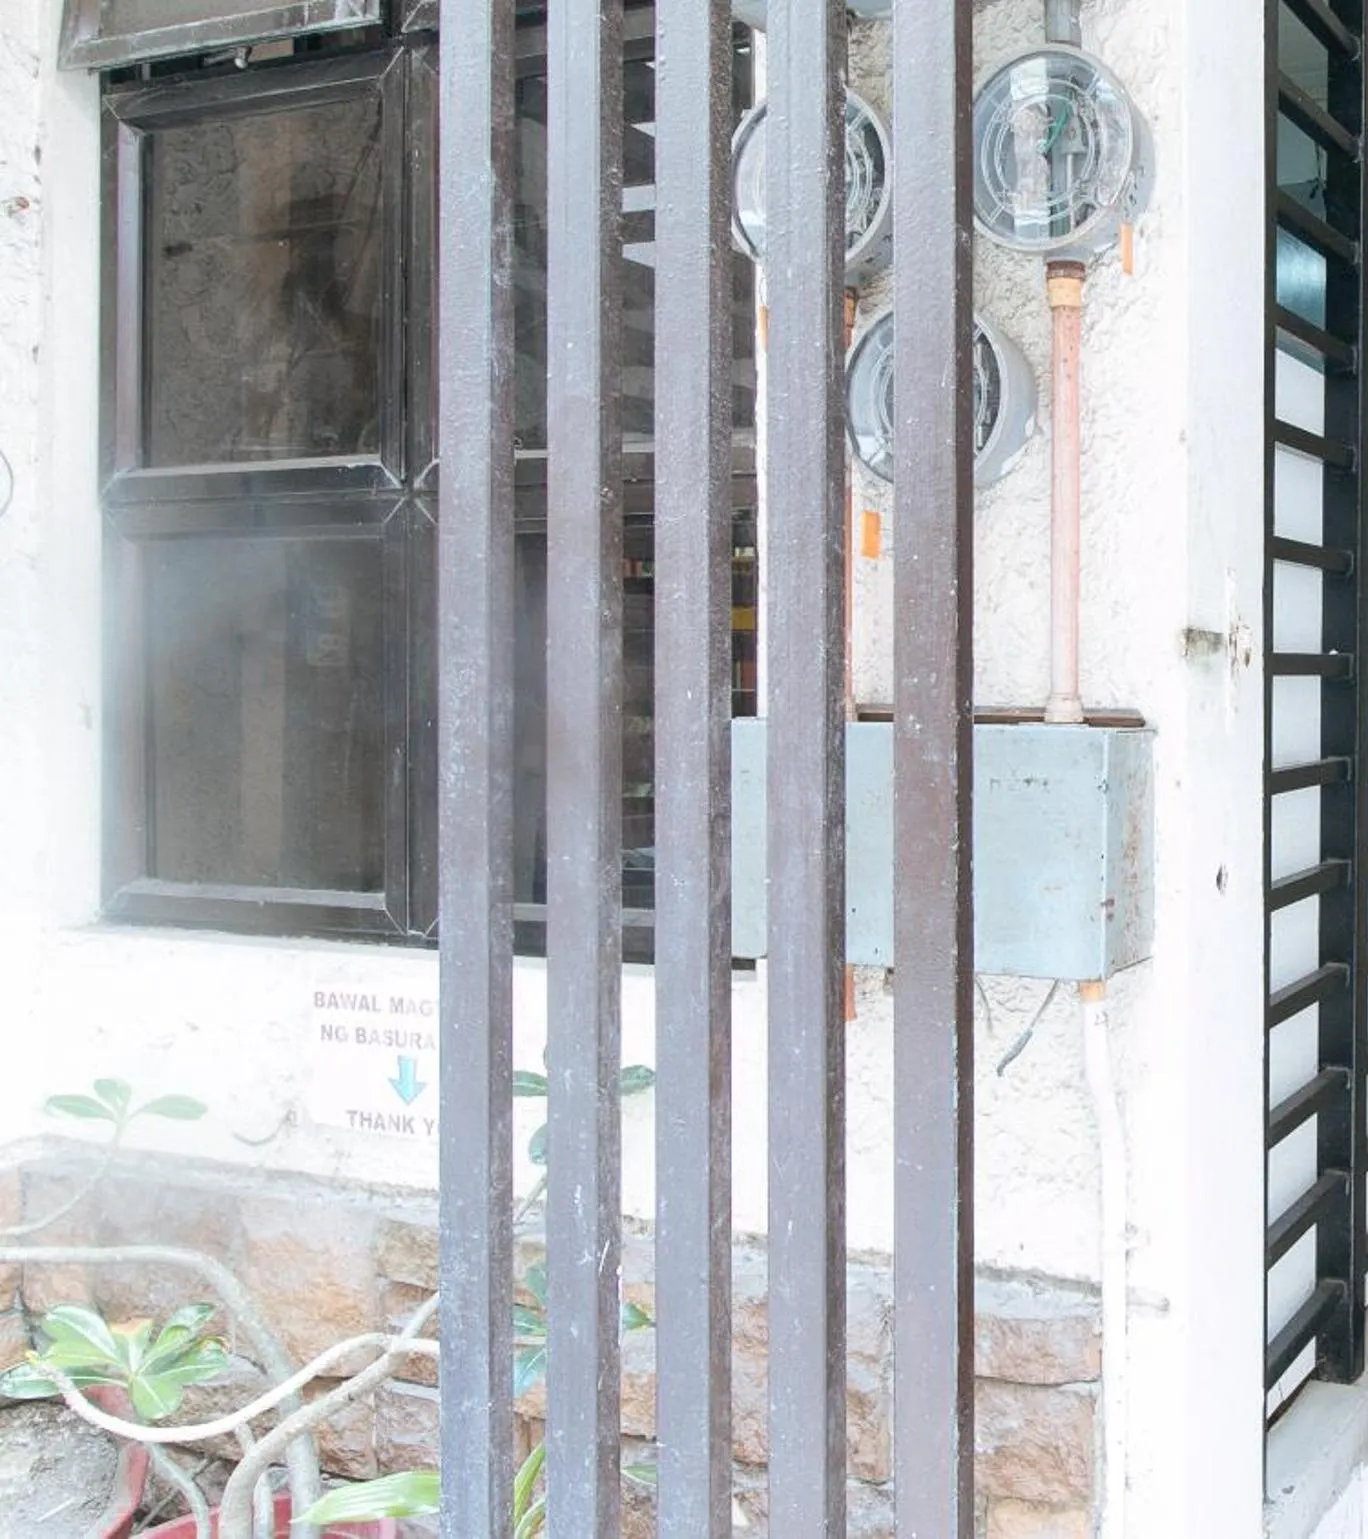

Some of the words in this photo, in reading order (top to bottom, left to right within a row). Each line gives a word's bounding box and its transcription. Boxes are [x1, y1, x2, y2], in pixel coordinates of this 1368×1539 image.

[314, 991, 381, 1013] BAWAL
[389, 996, 437, 1017] MAG
[320, 1024, 348, 1042] NG
[355, 1027, 436, 1050] BASURA
[345, 1109, 415, 1134] THANK
